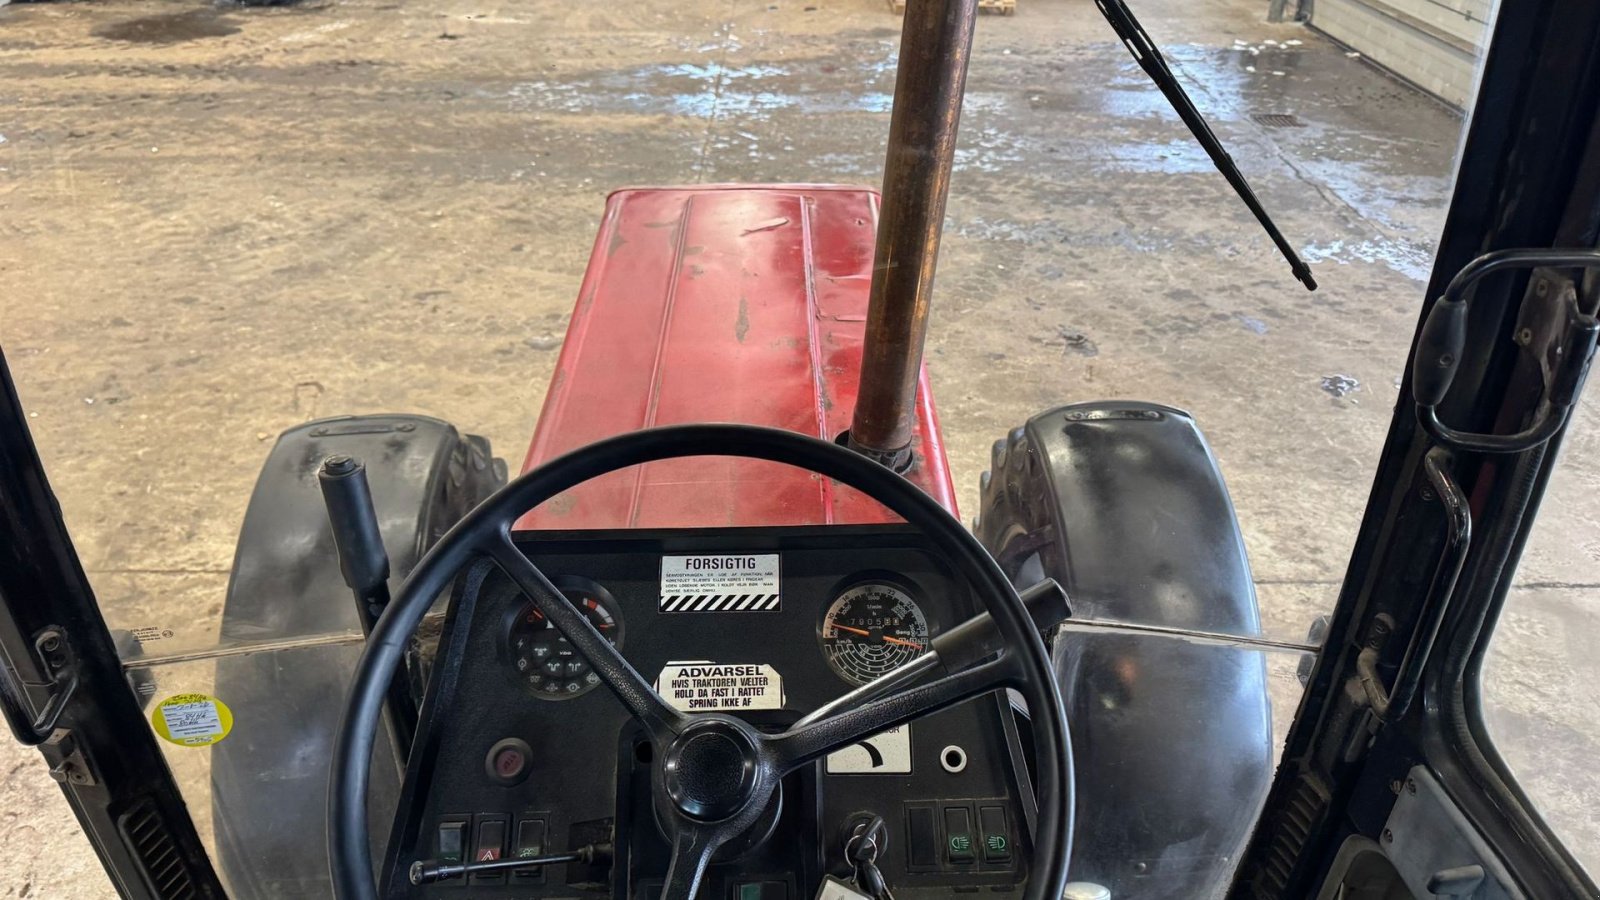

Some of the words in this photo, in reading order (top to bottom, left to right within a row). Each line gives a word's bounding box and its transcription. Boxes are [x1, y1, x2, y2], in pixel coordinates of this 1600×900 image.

[686, 557, 756, 570] FORSIGTIG
[678, 666, 764, 678] ADVARSEL
[671, 679, 689, 689] HVIS
[692, 678, 737, 688] TRAKTOREN
[740, 677, 768, 686] VÆLTER
[674, 689, 694, 699] HOLD
[698, 688, 708, 698] DA
[711, 688, 729, 697] FAST
[738, 687, 765, 696] RATTET
[689, 699, 718, 708] SPRING
[721, 698, 739, 707] IKKE
[742, 697, 752, 706] AF
